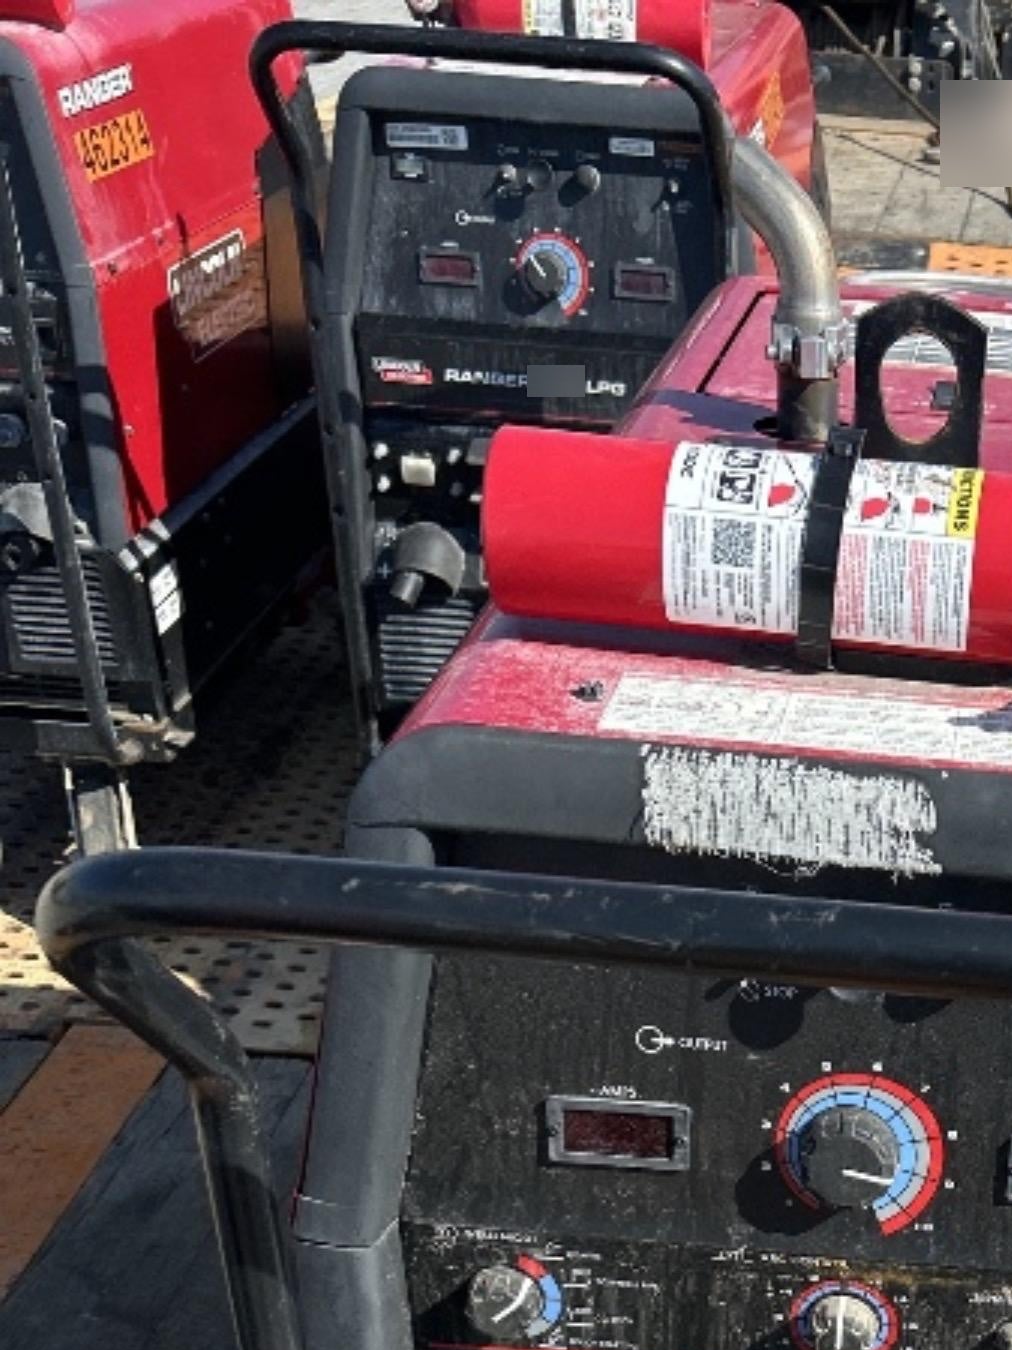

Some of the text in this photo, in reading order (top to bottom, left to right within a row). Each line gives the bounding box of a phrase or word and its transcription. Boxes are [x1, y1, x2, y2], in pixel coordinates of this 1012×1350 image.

[58, 63, 132, 117] RANGER
[585, 380, 627, 397] LPG
[677, 1037, 728, 1051] OUTPUT
